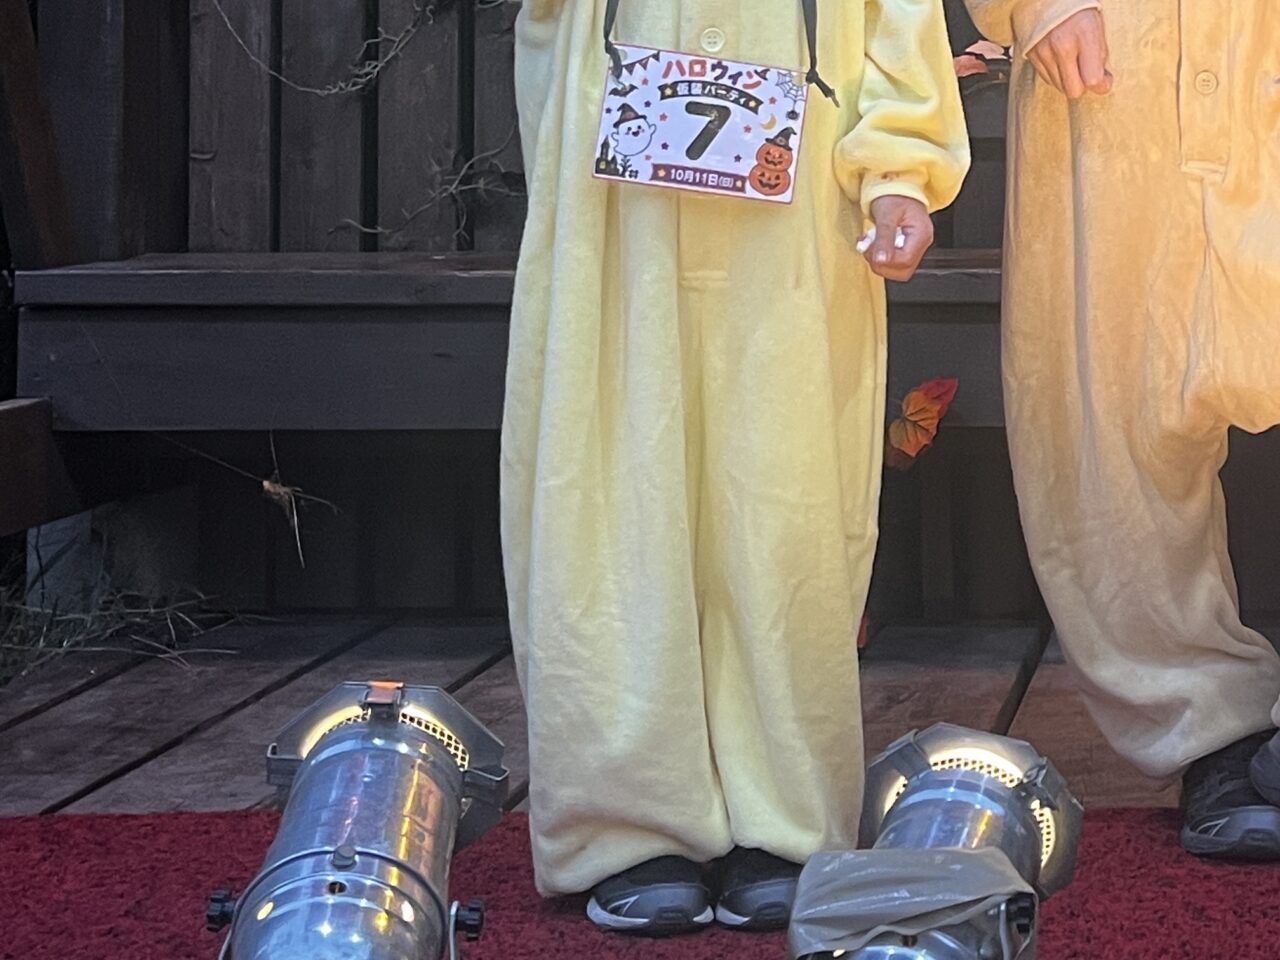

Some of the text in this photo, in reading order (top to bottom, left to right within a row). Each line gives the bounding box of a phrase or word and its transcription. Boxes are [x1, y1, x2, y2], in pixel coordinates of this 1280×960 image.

[662, 58, 763, 90] ハロウィン
[685, 100, 732, 161] 7
